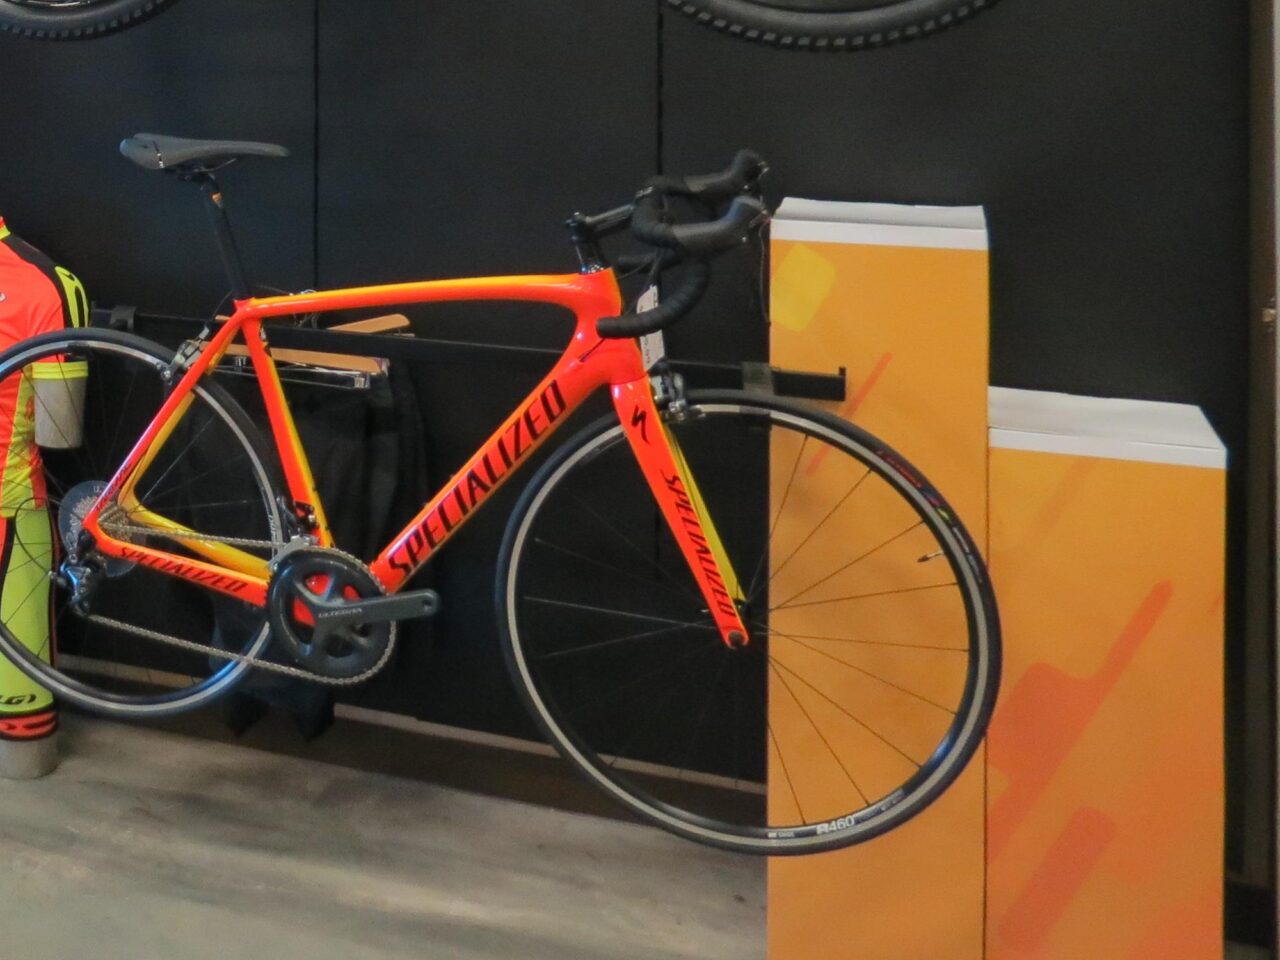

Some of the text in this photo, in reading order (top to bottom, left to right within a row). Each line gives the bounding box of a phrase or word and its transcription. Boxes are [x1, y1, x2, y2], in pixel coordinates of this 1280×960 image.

[388, 379, 567, 575] SPECIALIZED
[120, 546, 249, 592] SPECIALIZED
[660, 469, 737, 617] SPECIALIZED
[816, 815, 855, 834] R460
